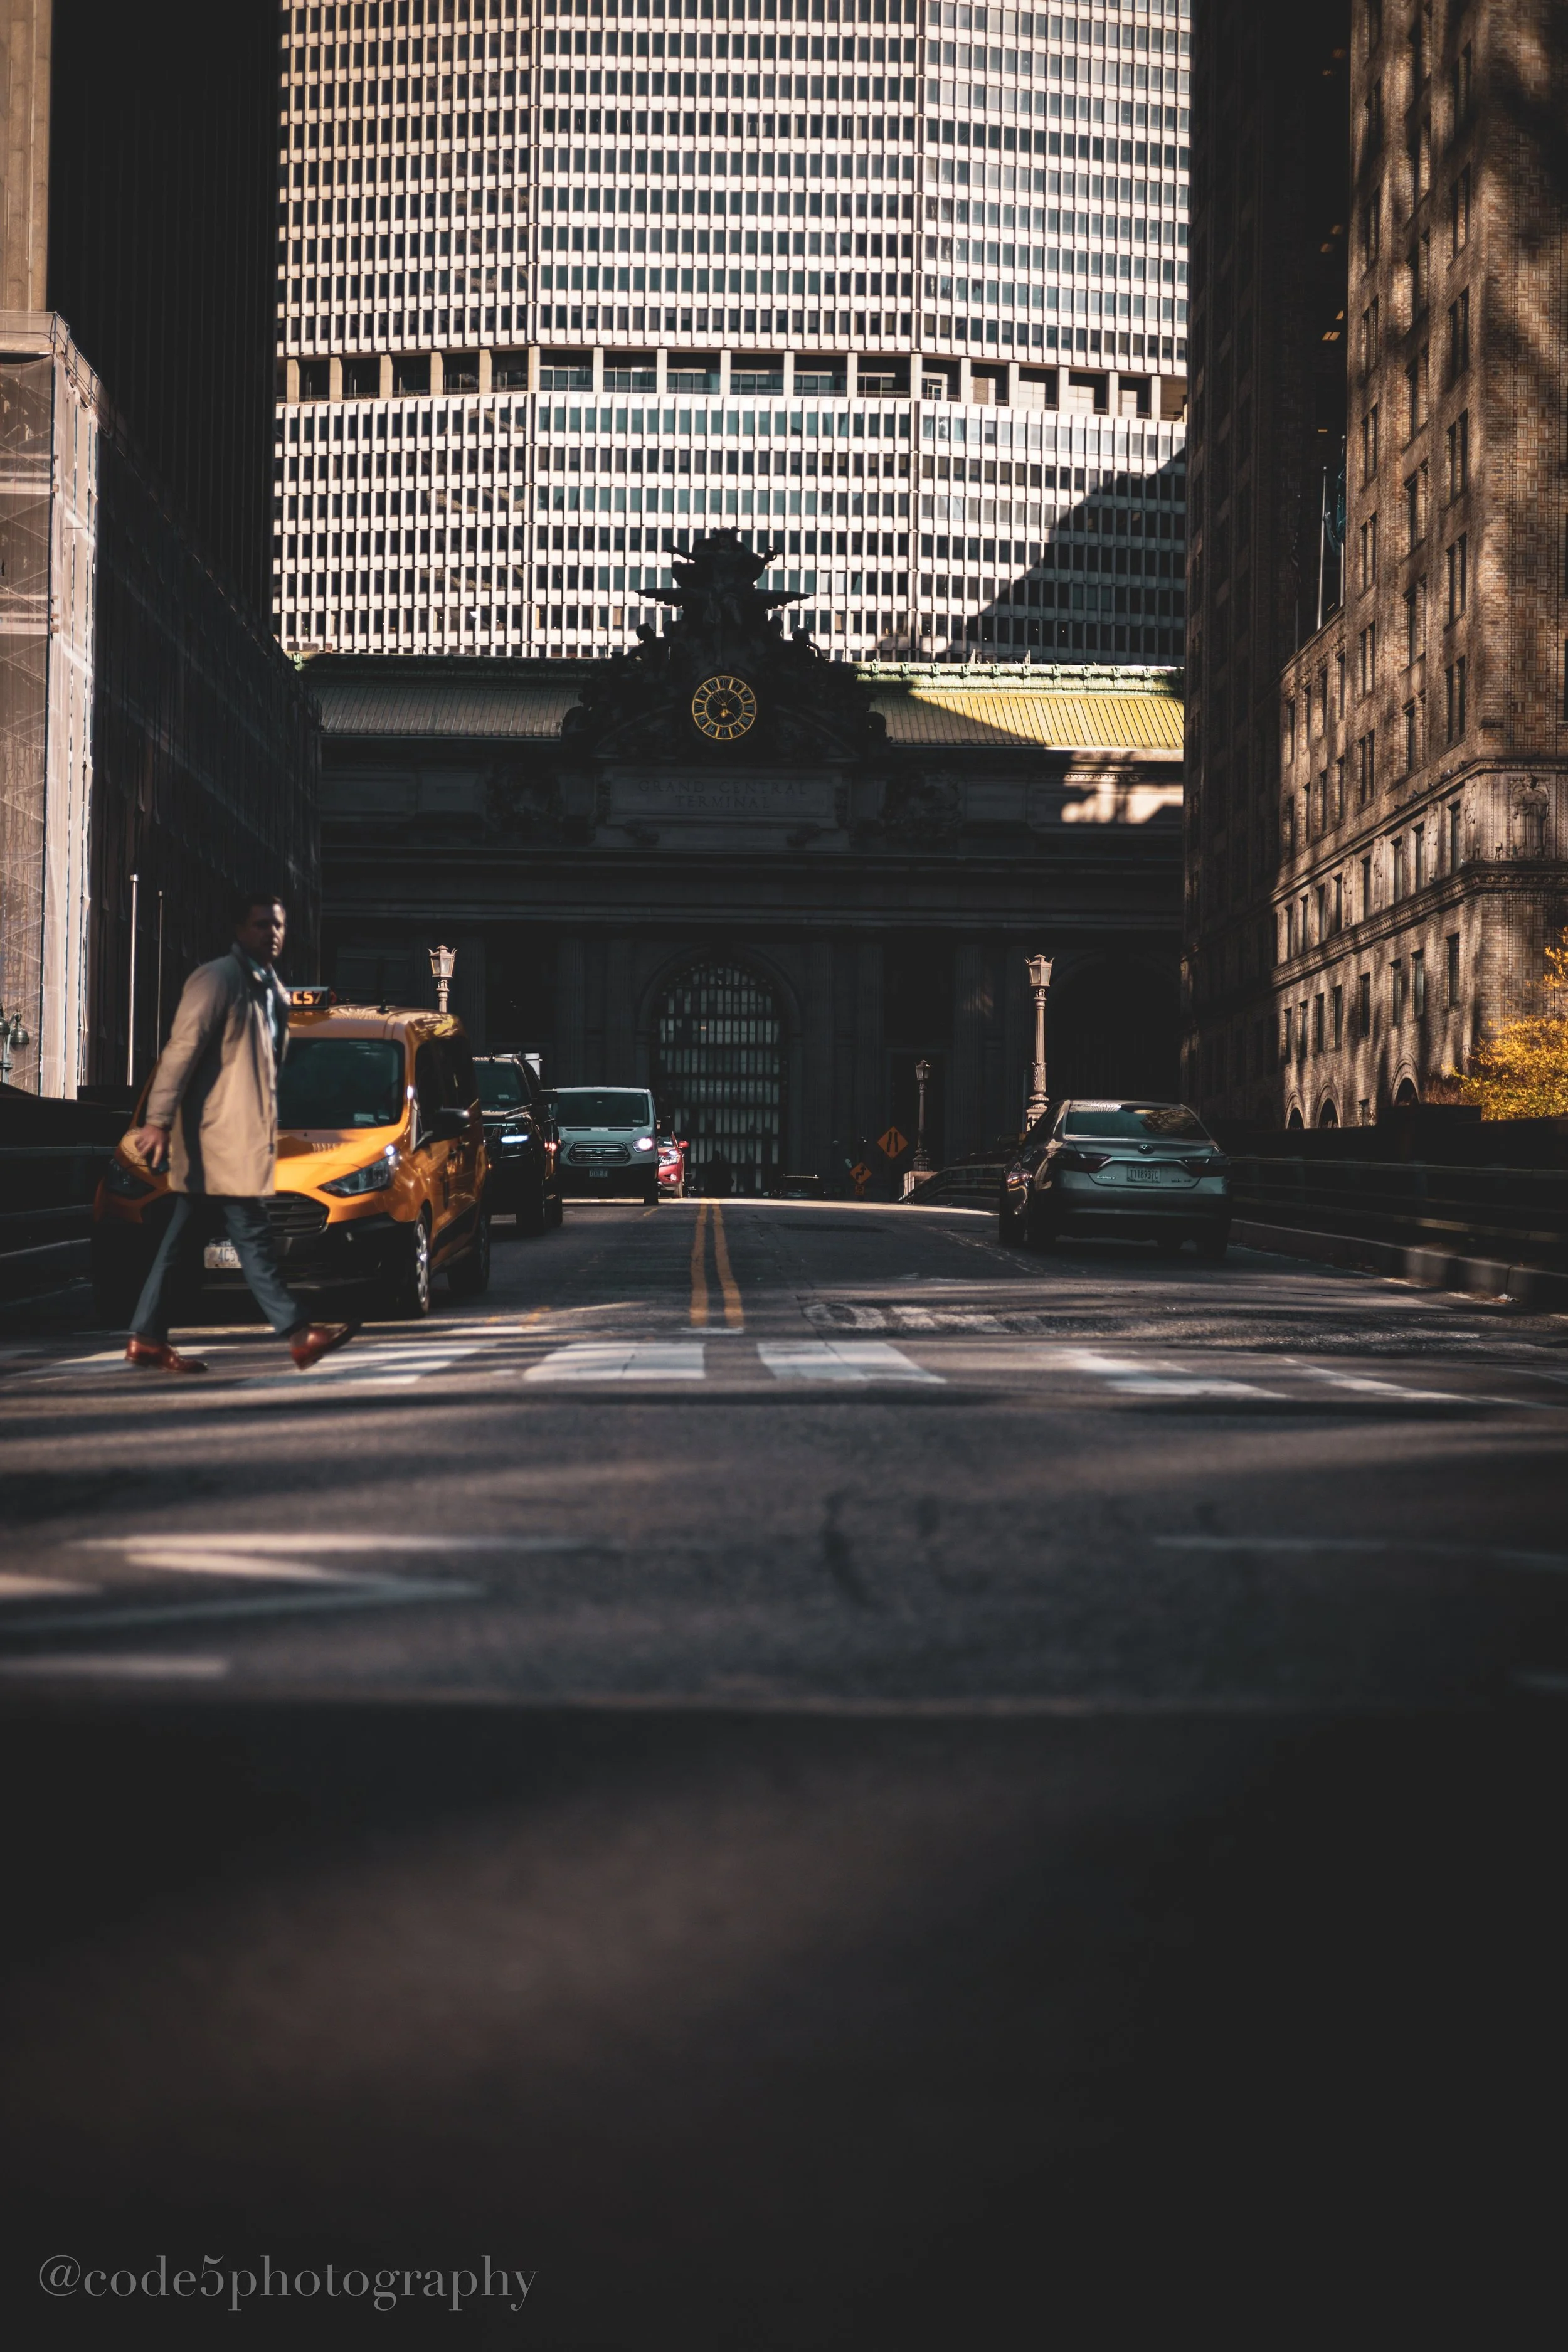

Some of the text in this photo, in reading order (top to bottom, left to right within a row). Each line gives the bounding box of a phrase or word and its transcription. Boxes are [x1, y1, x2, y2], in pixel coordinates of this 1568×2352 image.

[638, 780, 807, 795] GRAND CENTRAL
[674, 795, 770, 809] TERMINAL
[289, 990, 322, 1005] C57
[218, 1248, 236, 1262] 4C5
